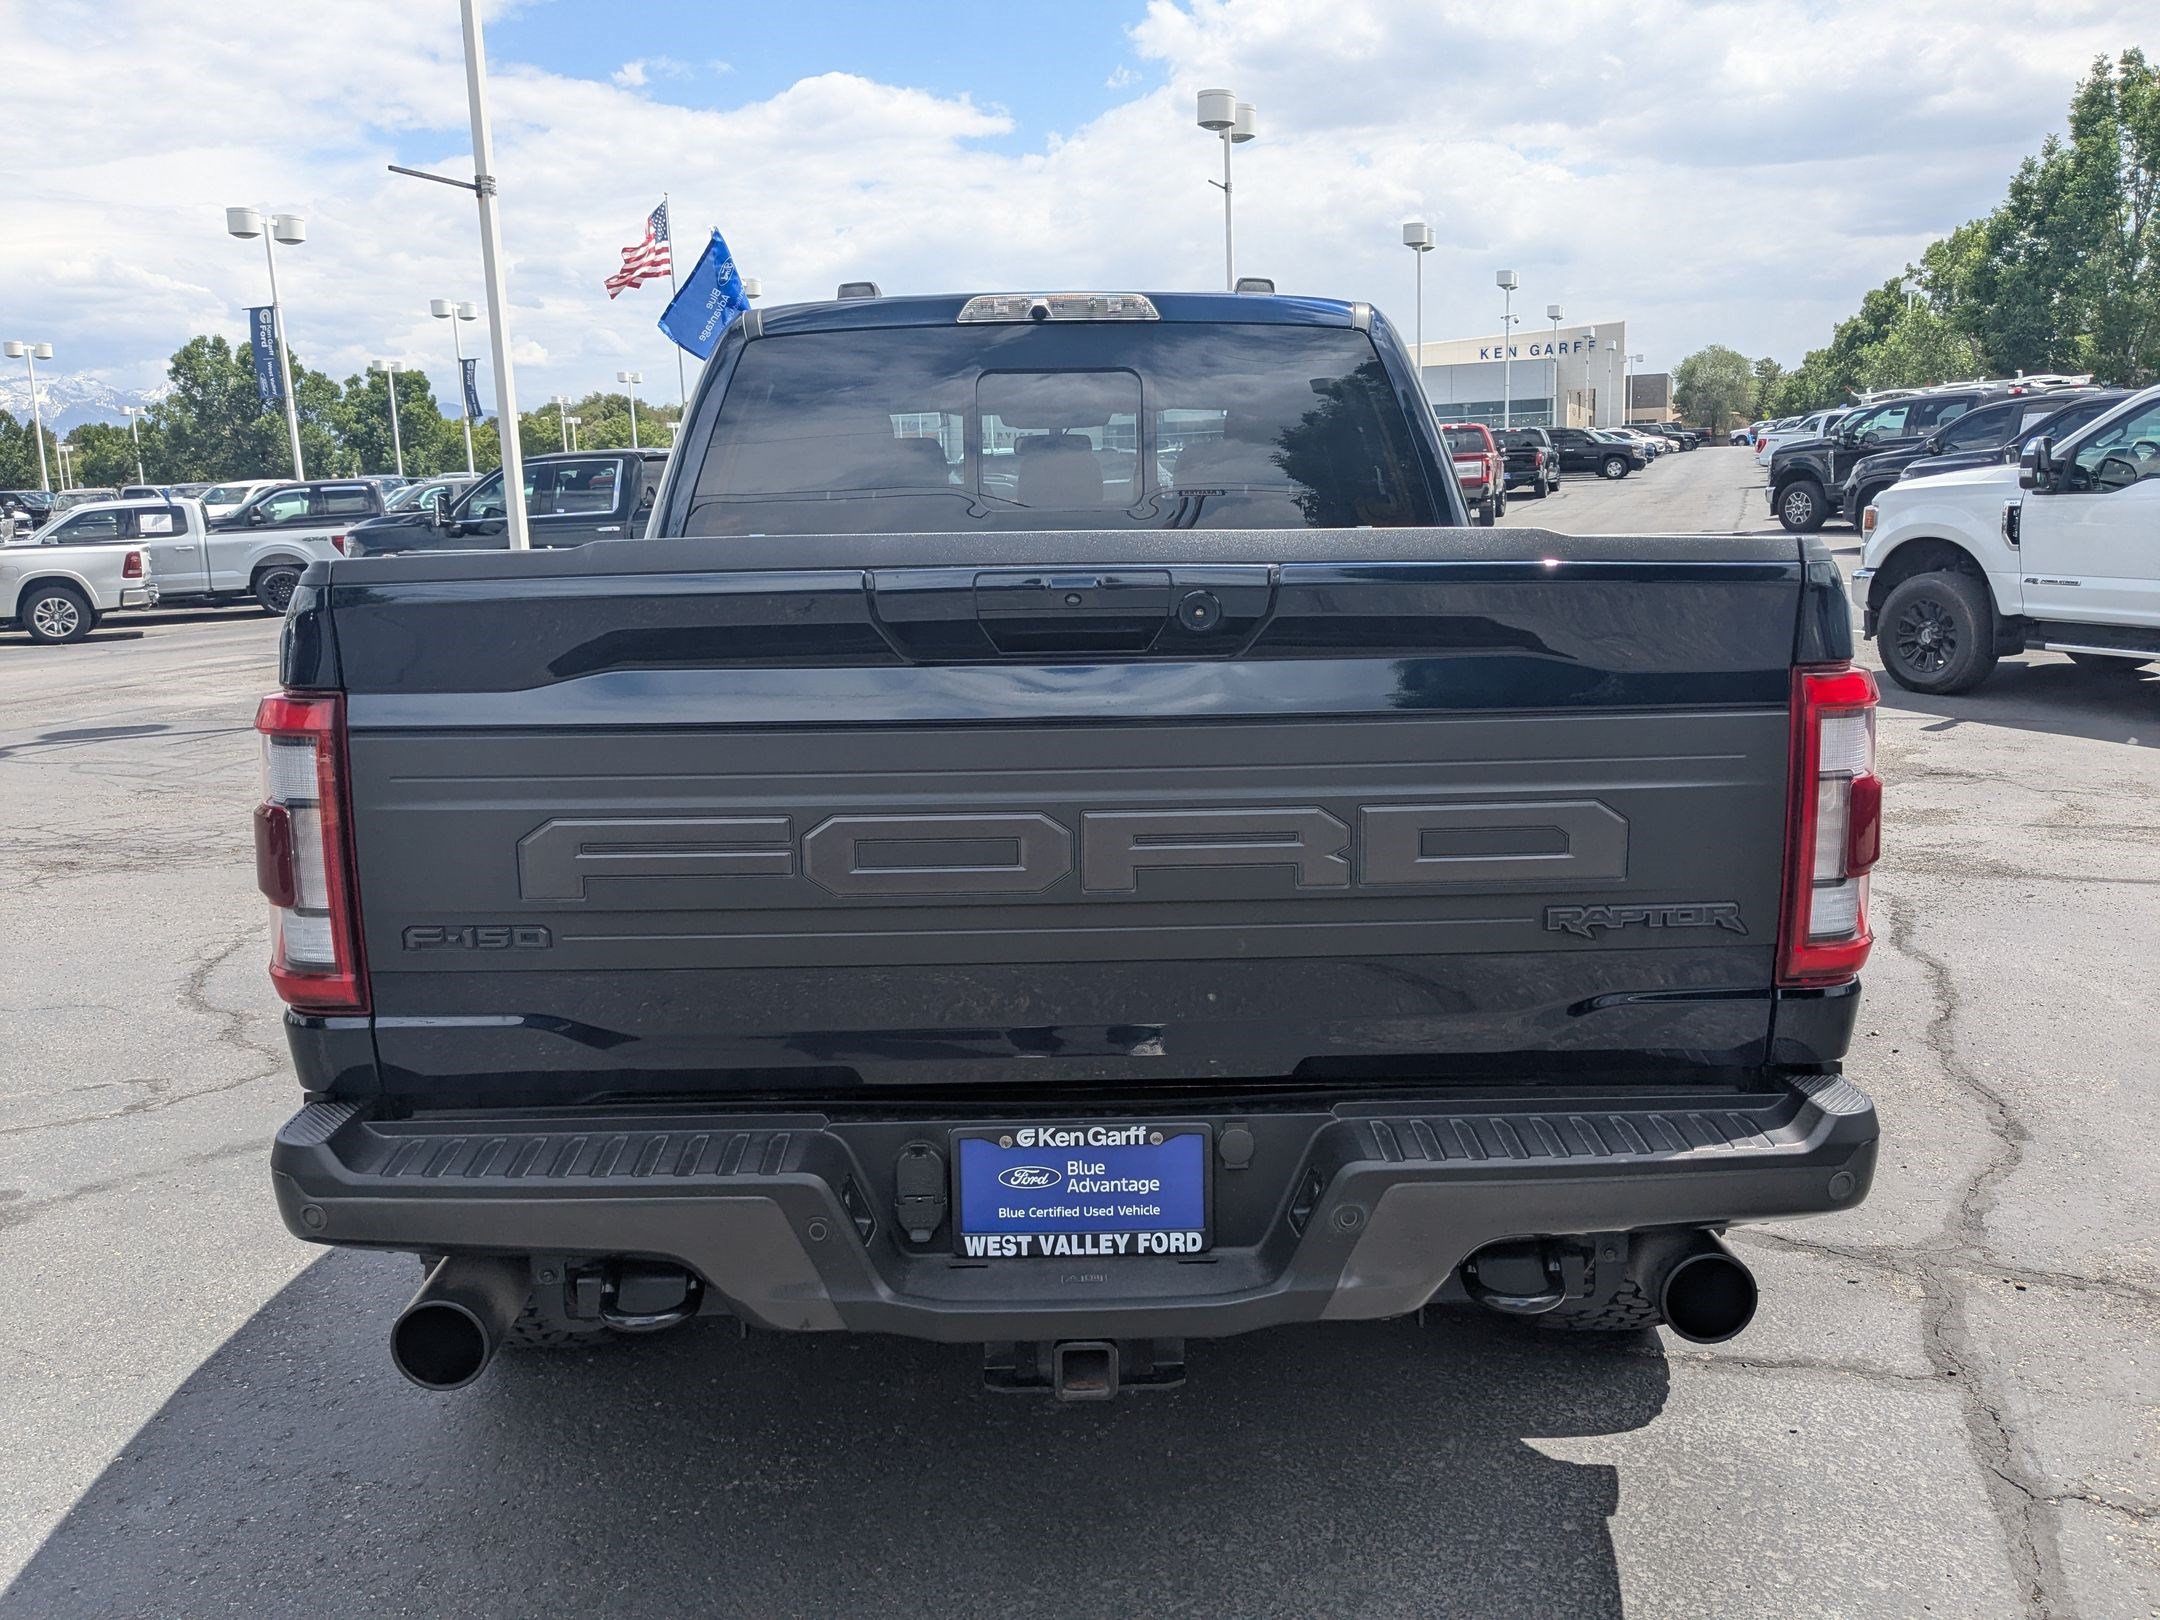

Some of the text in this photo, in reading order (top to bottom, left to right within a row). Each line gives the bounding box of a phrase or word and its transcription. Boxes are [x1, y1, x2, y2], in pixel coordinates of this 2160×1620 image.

[260, 325, 268, 347] Ford
[1480, 340, 1596, 360] KEN GARFF
[516, 800, 1631, 901] FORD
[1543, 900, 1749, 940] RAPTOR
[402, 925, 553, 951] F-150
[1038, 1126, 1146, 1147] Ken Garff
[1010, 1168, 1050, 1186] Ford
[1067, 1160, 1105, 1175] Blue
[1066, 1177, 1160, 1195] Advantage
[998, 1204, 1161, 1218] Blue Certified Used Vehicle
[964, 1232, 1203, 1257] WEST VALLEY FORD
